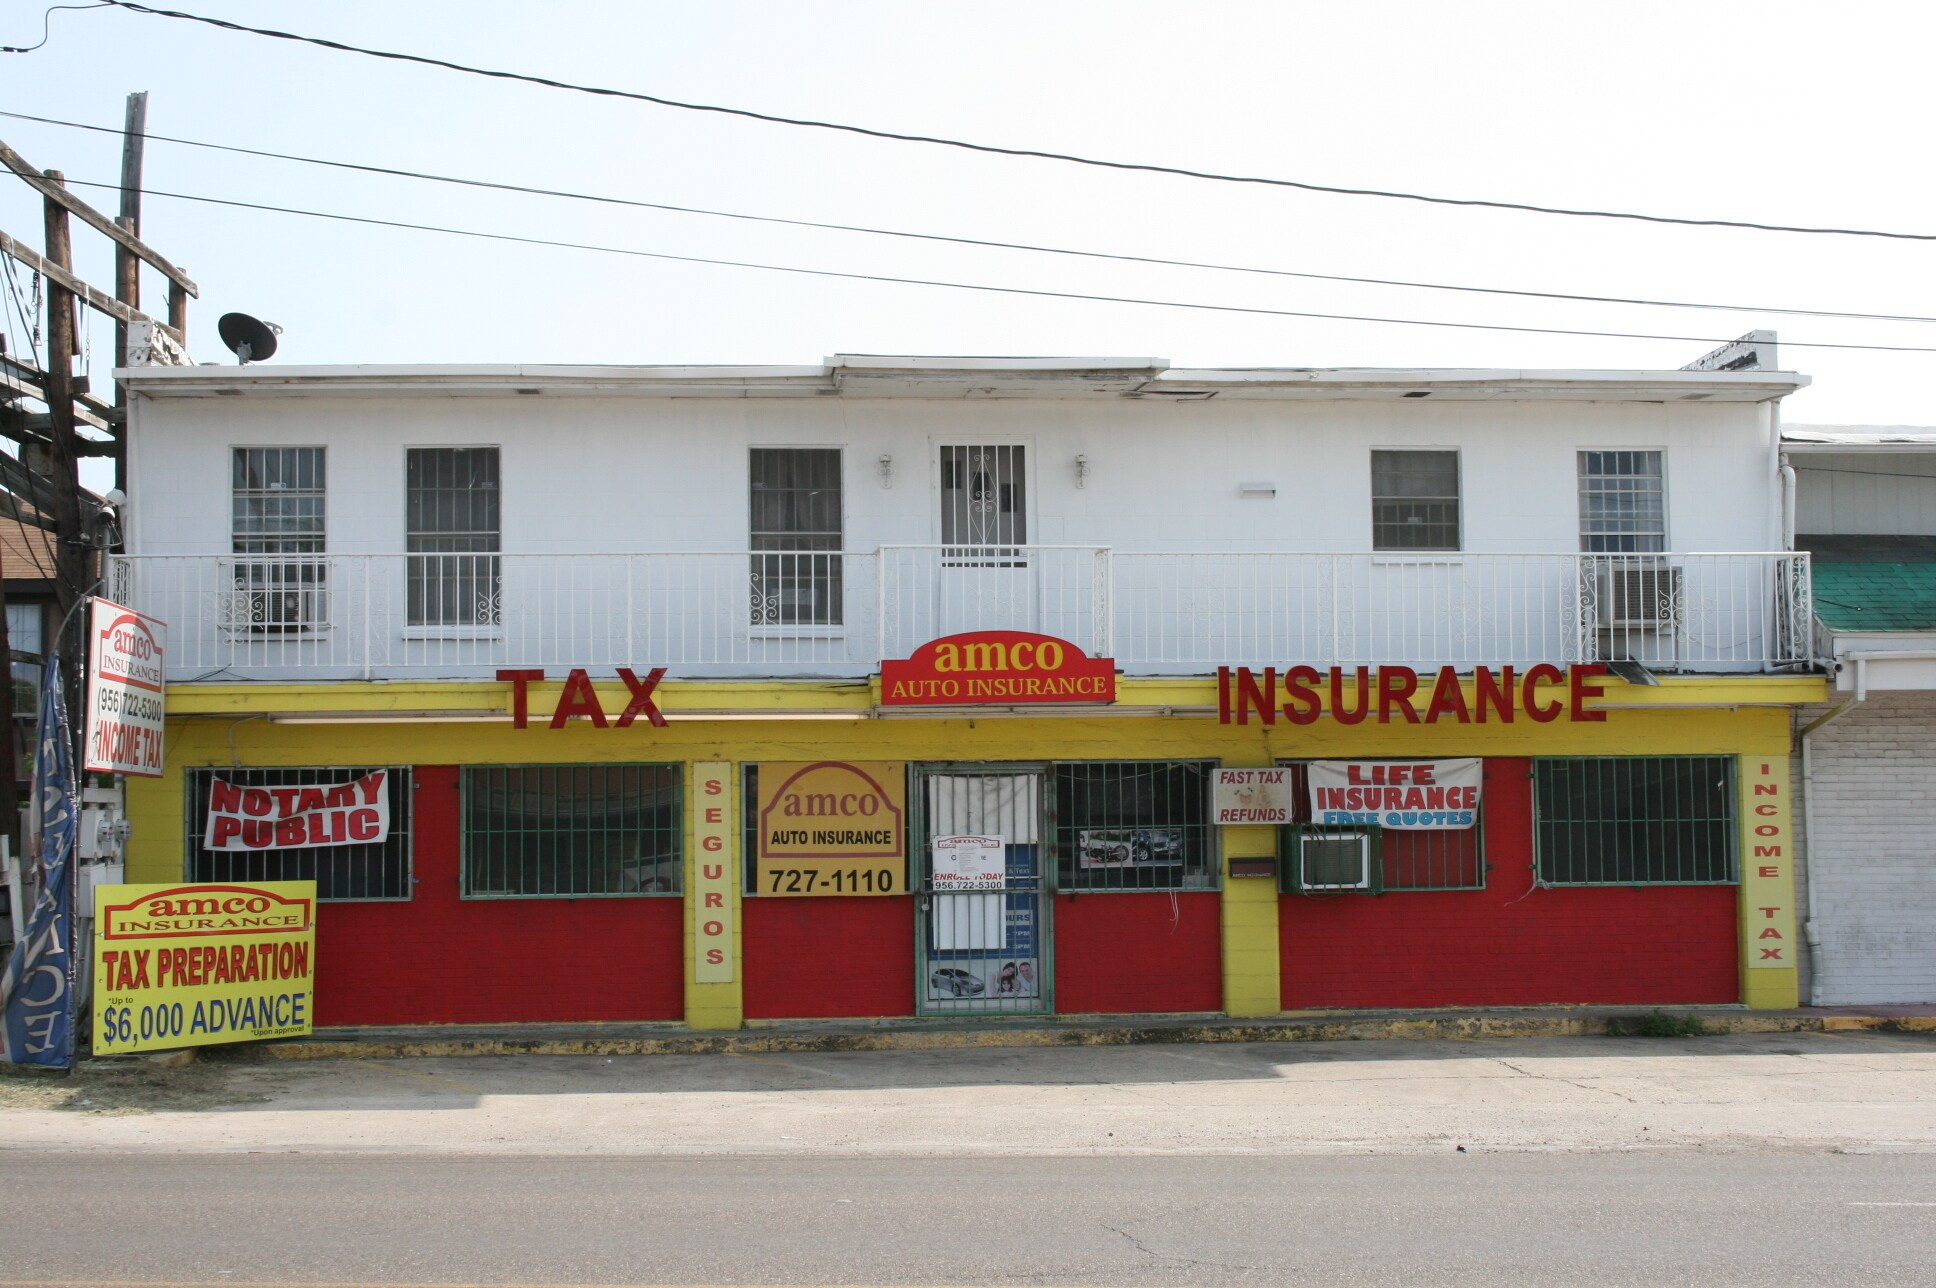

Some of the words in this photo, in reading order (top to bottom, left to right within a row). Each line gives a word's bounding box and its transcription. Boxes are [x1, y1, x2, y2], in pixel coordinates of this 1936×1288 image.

[114, 629, 151, 661] amco
[934, 641, 1064, 673] amco
[104, 655, 159, 682] INSURANCE
[496, 668, 670, 729] TAX
[891, 679, 959, 698] AUTO
[967, 676, 1107, 696] INSURANCE
[1217, 664, 1607, 725] INSURANCE
[97, 687, 162, 722] (956)722-5300
[97, 720, 142, 766] INCOME
[144, 729, 163, 769] TAX
[1220, 771, 1254, 784] FAST
[1258, 770, 1284, 784] TAX
[1347, 764, 1437, 785] LIFE
[211, 772, 386, 818] NOTARY
[783, 792, 880, 817] amco
[1316, 786, 1478, 811] INSURANCE
[212, 808, 380, 848] PUBLIC
[1220, 808, 1286, 822] REFUNDS
[1323, 811, 1380, 825] FREE
[1386, 811, 1473, 827] QUOTES
[1753, 763, 1782, 878] INCOME
[771, 830, 808, 845] AUTO
[812, 830, 892, 845] INSURANCE
[702, 779, 724, 965] SEGUROS
[768, 869, 893, 893] 727-1110
[935, 881, 1002, 890] 956.722-5300
[148, 896, 271, 917] amco
[118, 915, 299, 932] INSURANCE
[1758, 907, 1784, 960] TAX
[103, 949, 150, 991] TAX
[157, 941, 309, 987] PREPARATION
[124, 996, 134, 1004] to
[103, 1002, 184, 1047] $6,000
[189, 992, 306, 1035] ADVANCE
[274, 1026, 305, 1036] approval
